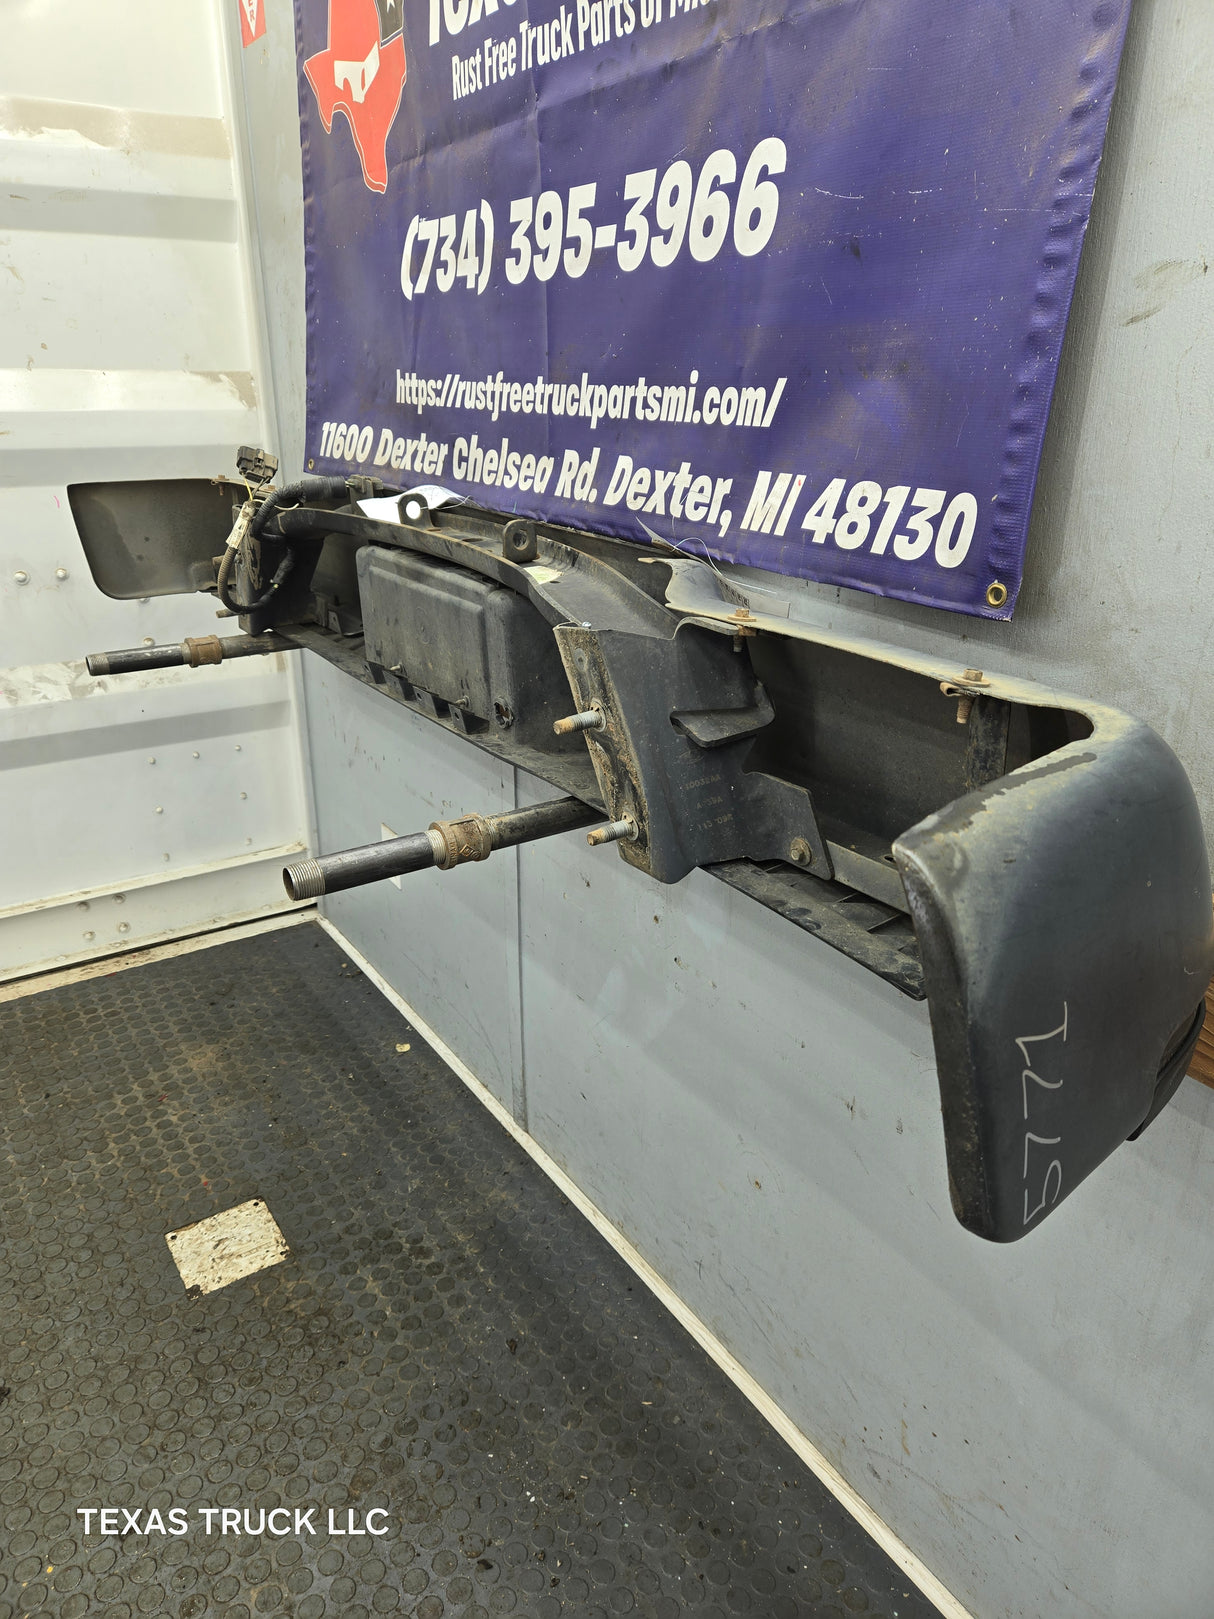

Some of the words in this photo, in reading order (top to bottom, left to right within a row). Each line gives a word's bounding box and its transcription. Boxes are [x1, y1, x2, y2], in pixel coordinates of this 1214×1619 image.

[452, 48, 482, 100] Rust
[484, 37, 517, 86] Free
[519, 5, 574, 72] Truck
[577, 0, 636, 51] Parts
[401, 199, 494, 300] (734)
[505, 137, 787, 285] 395-3966
[396, 369, 787, 429] https://rustfreetruckpartsmi.com/
[319, 421, 373, 464] 11600
[373, 428, 448, 476] Dexter
[453, 435, 554, 493] Chelsea
[555, 447, 600, 503] Rd.
[609, 455, 733, 537] Dexter,
[740, 471, 806, 536] MI
[801, 475, 977, 568] 48130
